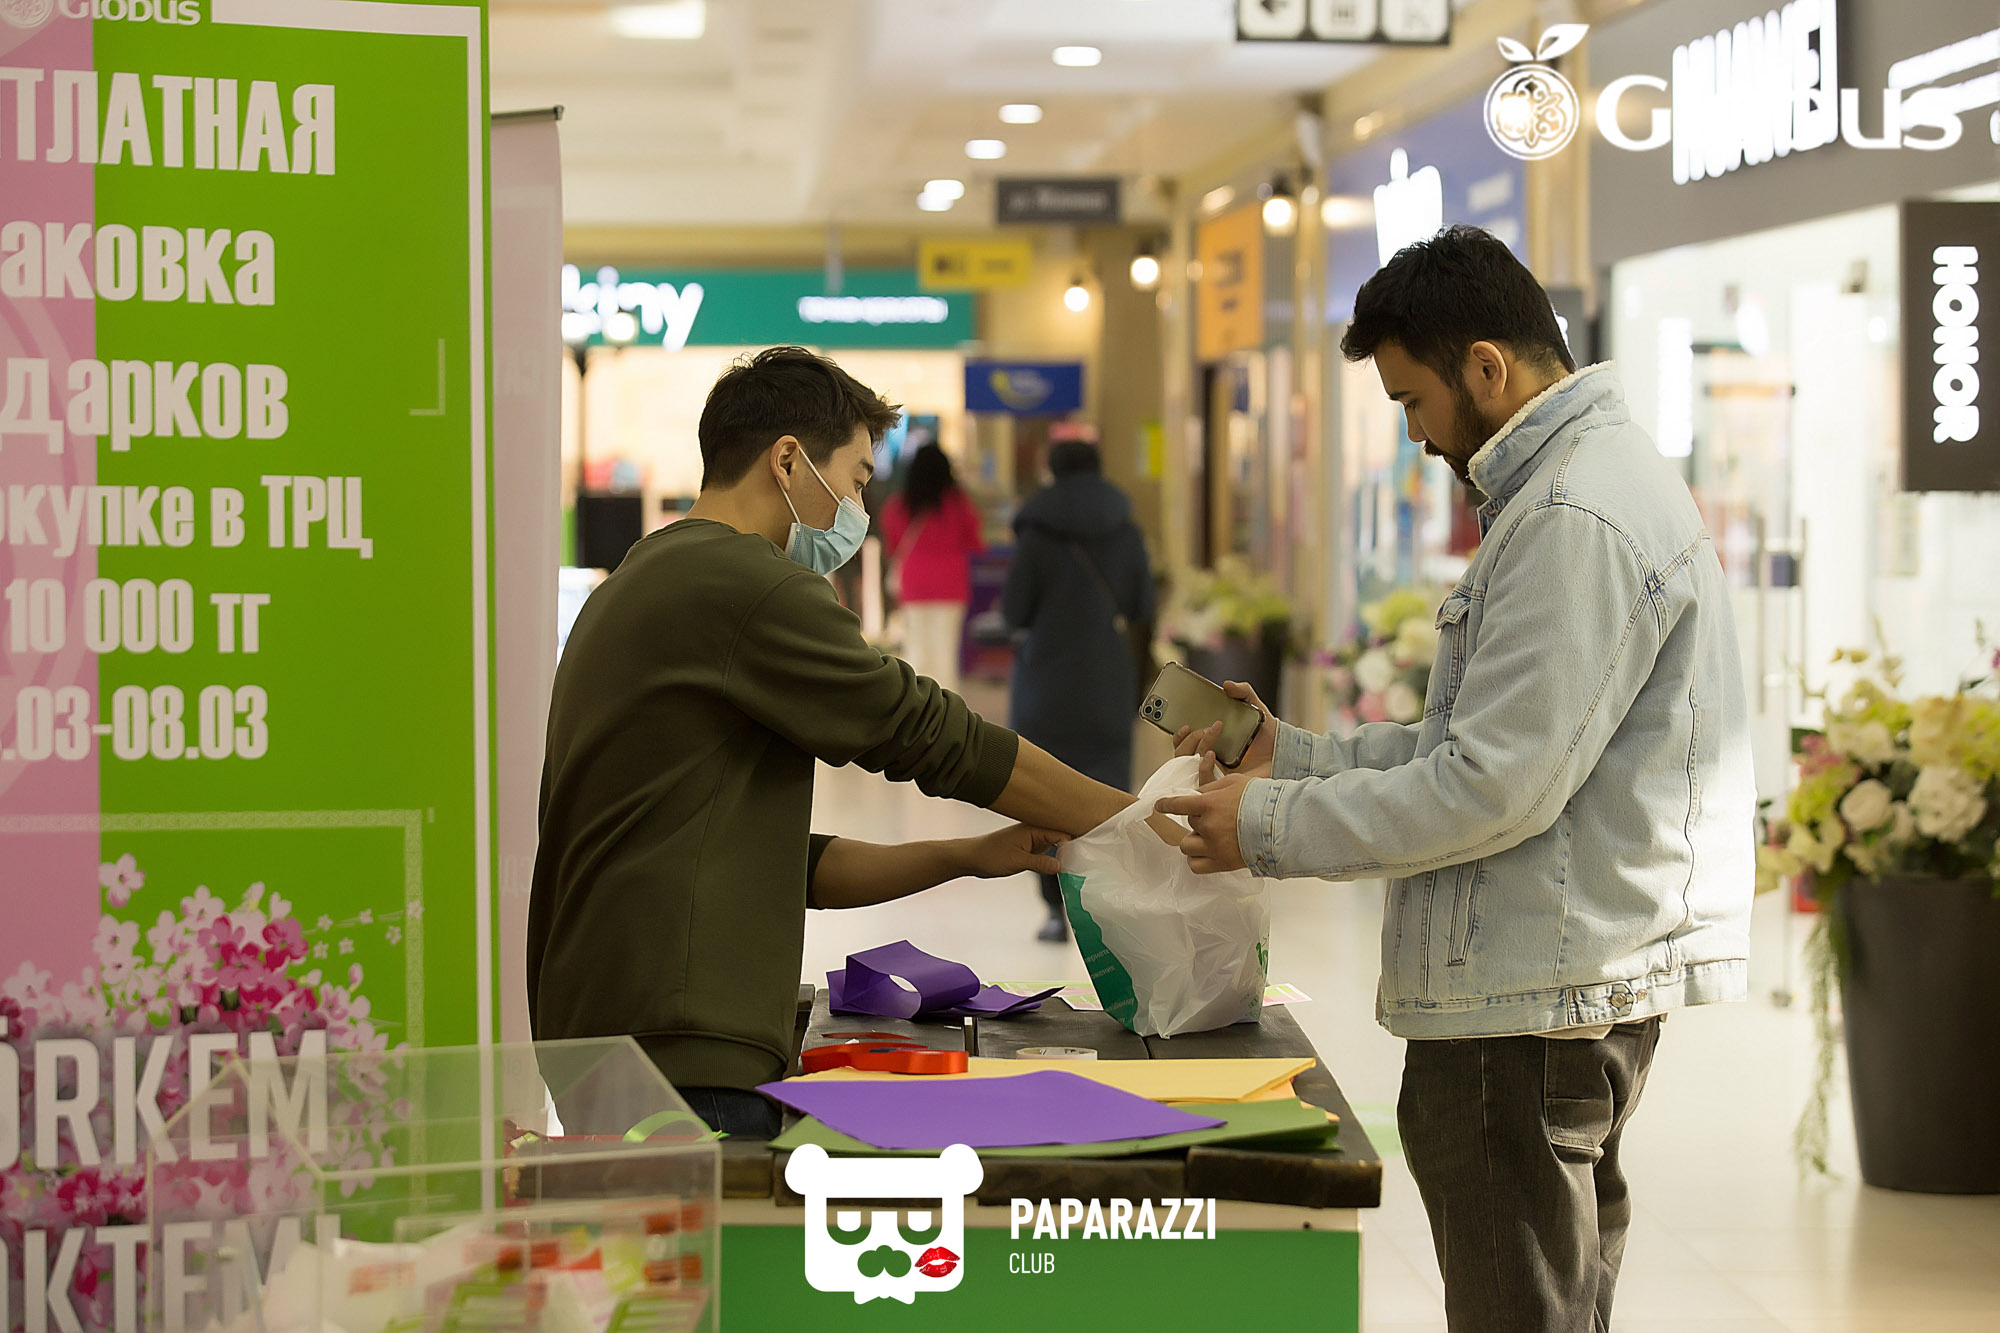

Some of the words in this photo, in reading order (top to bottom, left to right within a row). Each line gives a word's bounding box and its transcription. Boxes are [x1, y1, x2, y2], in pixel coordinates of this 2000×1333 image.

[0, 220, 276, 306] аковка
[1932, 245, 1980, 444] HONOR
[0, 484, 195, 557] купке
[211, 487, 246, 548] в
[260, 474, 374, 560] ТРЦ
[5, 578, 66, 654] 10
[84, 578, 195, 654] 000
[210, 593, 271, 653] тг
